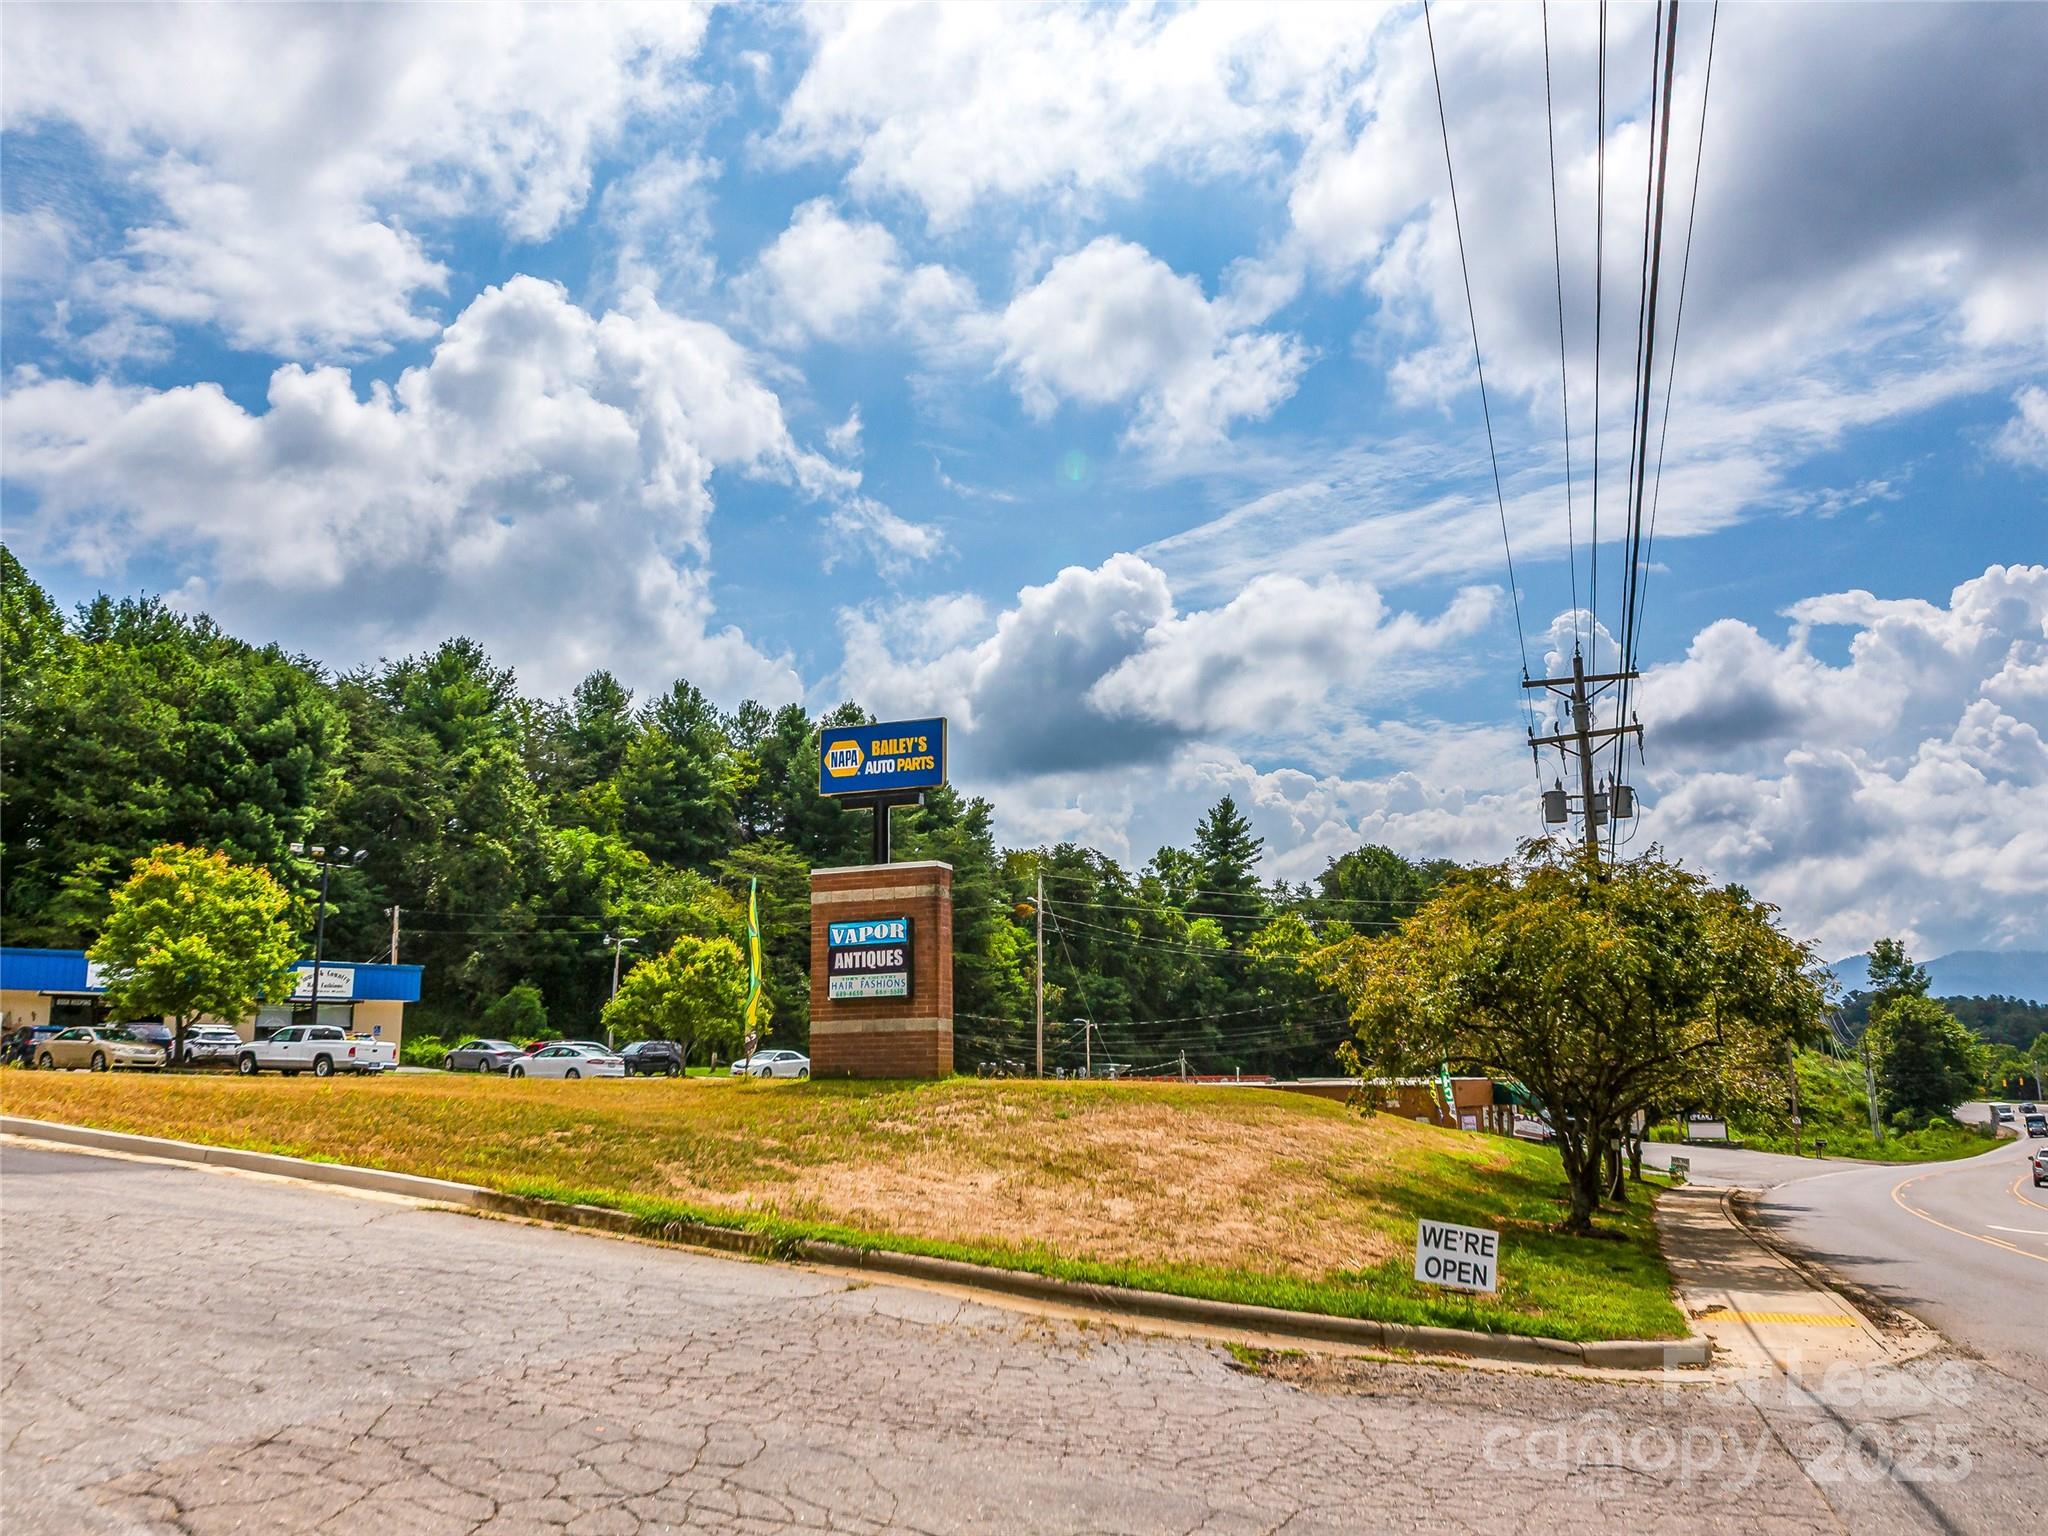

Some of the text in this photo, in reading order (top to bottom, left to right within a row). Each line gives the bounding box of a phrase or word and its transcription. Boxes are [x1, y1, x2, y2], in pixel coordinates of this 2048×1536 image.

[871, 736, 928, 756] BAILEY'S
[830, 749, 858, 768] NAPA
[865, 755, 935, 775] AUTO PARTS
[832, 923, 905, 944] VAPOR
[834, 949, 904, 969] ANTIQUES
[831, 979, 906, 990] HAIR FASHIONS
[1422, 1224, 1495, 1258] WE'RE
[1424, 1256, 1487, 1286] OPEN
